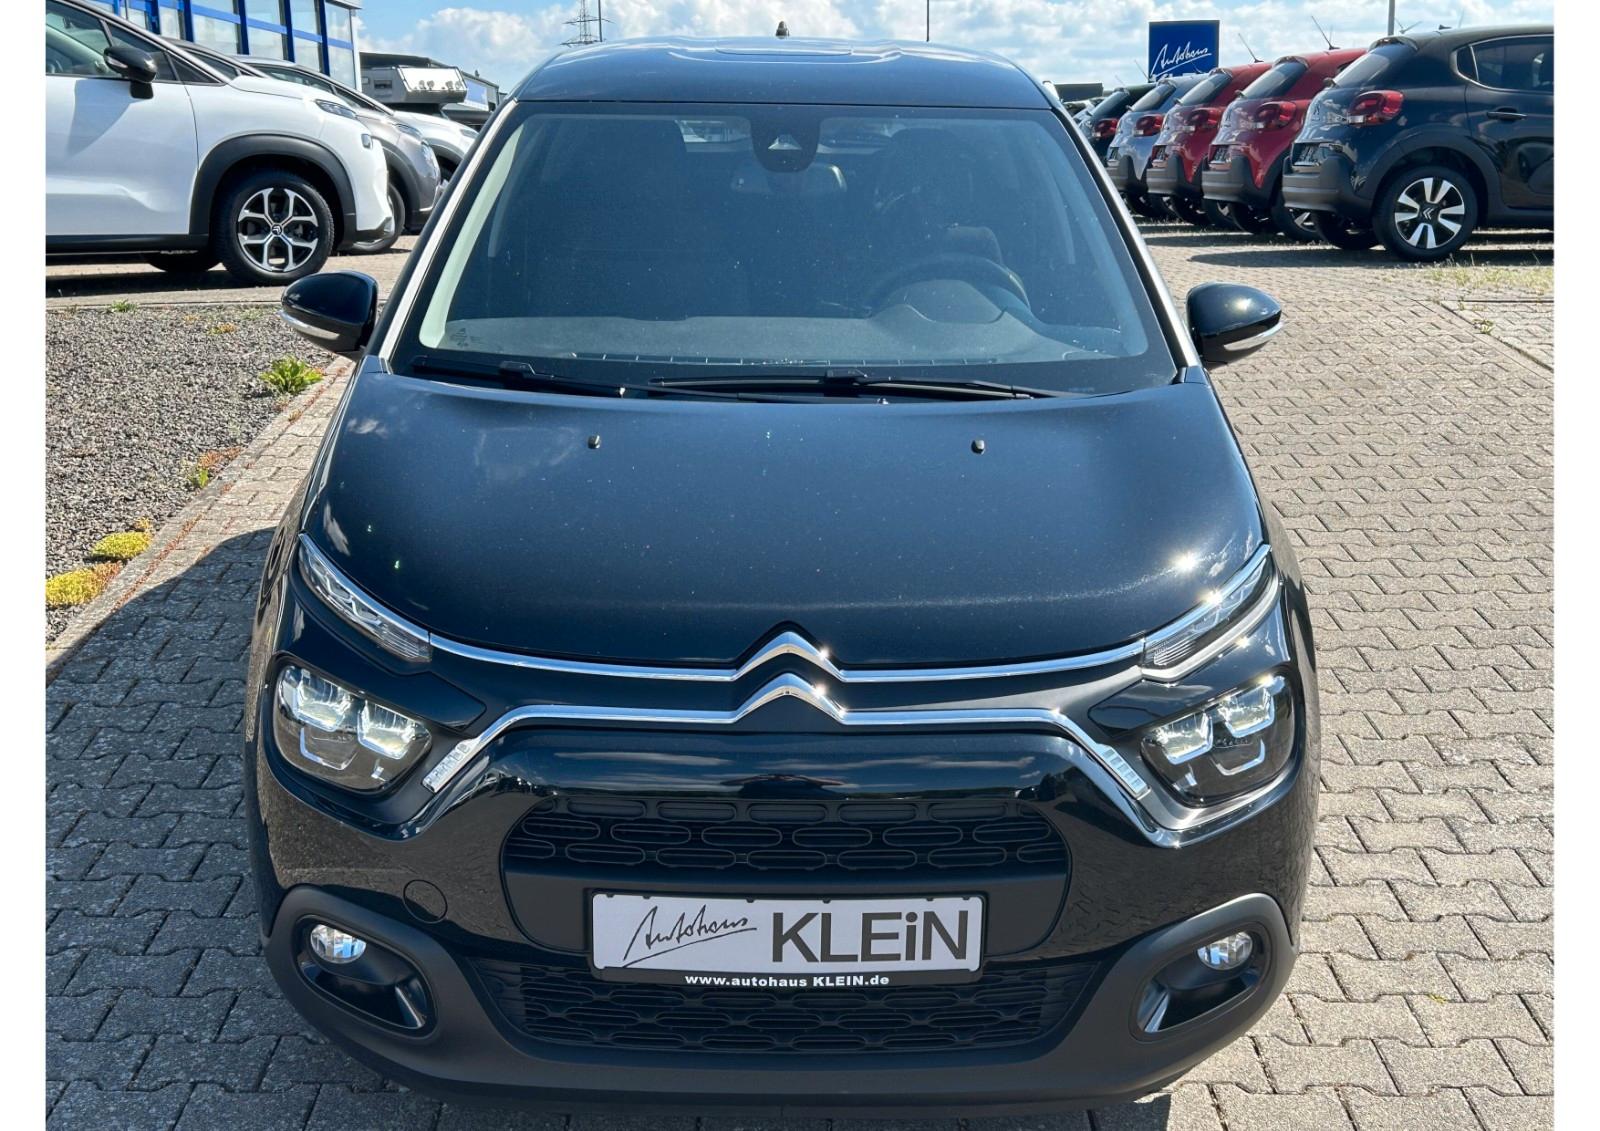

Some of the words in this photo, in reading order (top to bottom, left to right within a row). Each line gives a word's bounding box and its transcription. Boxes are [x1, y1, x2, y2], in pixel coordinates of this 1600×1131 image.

[1150, 41, 1209, 76] Autohaus
[623, 905, 750, 961] Autohaus
[684, 974, 808, 987] www.autohaus
[813, 975, 890, 987] KLEIN.de
